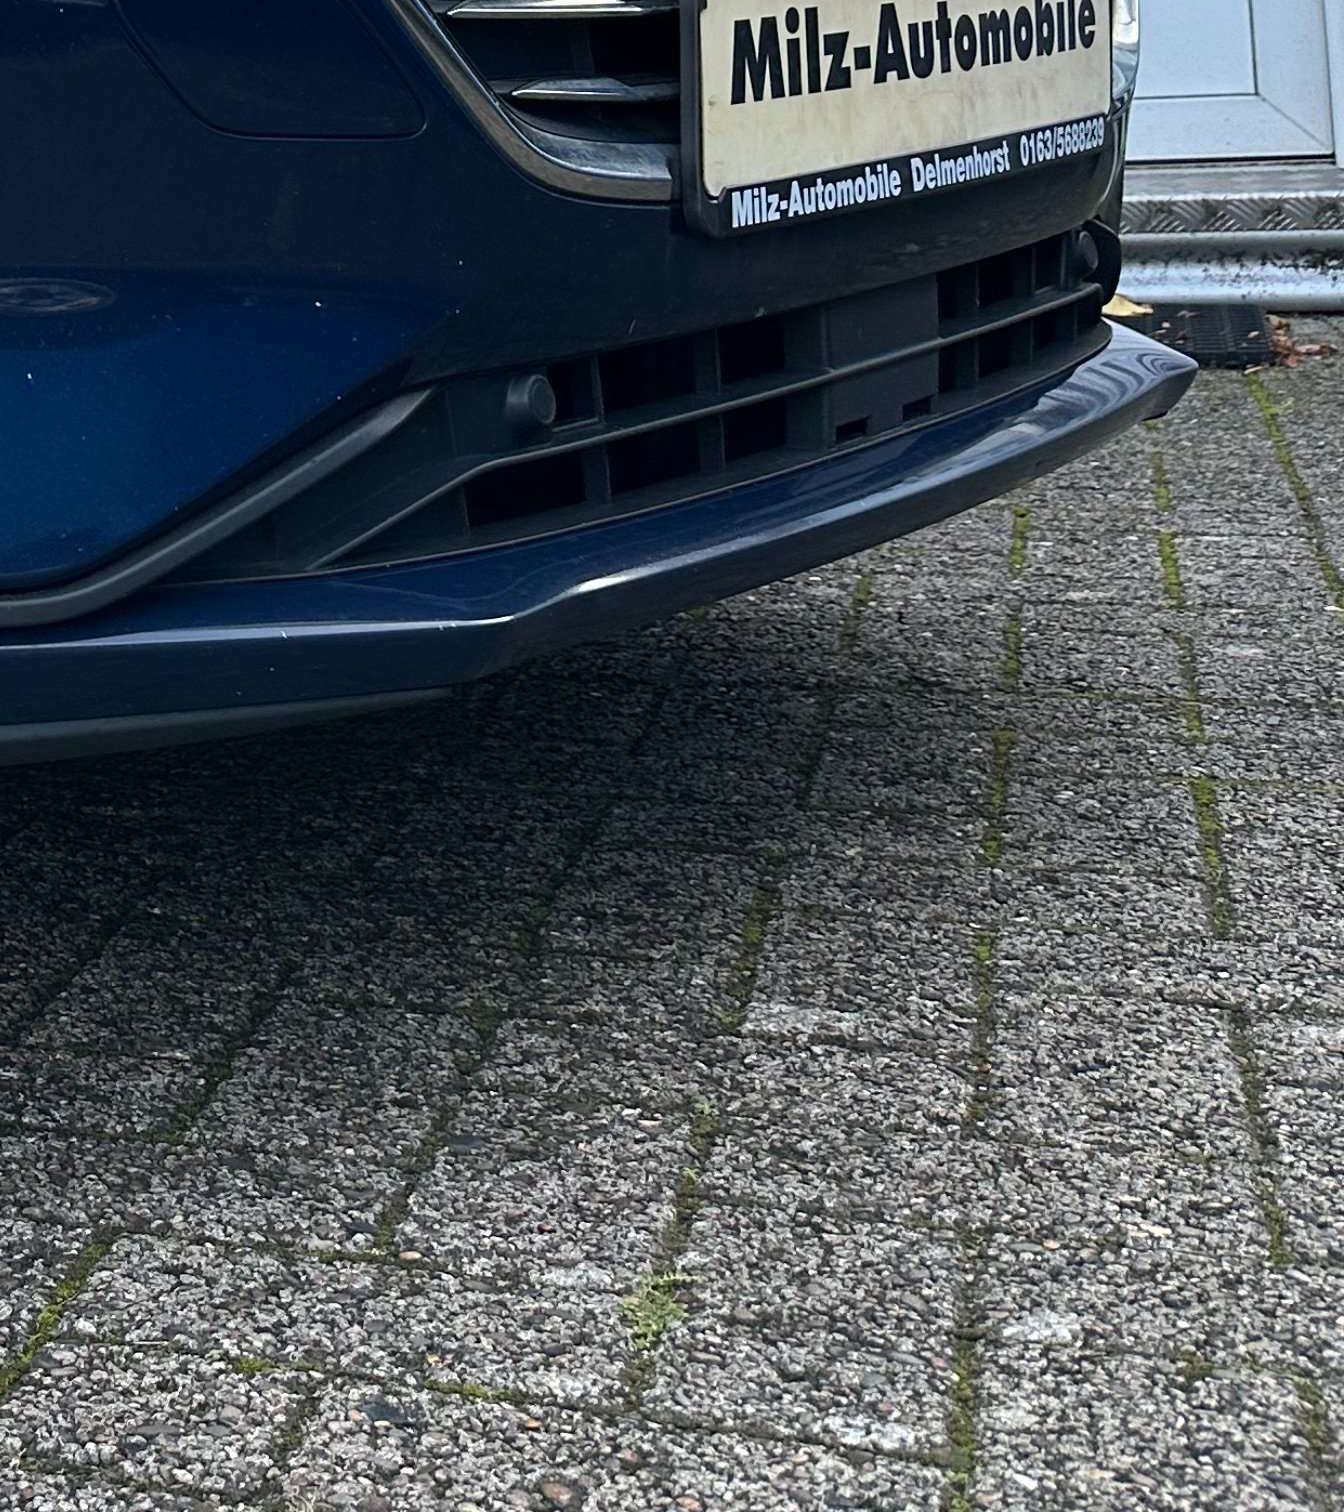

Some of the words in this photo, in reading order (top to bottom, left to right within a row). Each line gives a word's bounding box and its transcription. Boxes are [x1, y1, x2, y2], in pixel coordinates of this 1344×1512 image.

[731, 169, 902, 229] Milz-Automobile
[911, 141, 1011, 194] Delmenhorst
[1019, 116, 1105, 168] 0163/5688239
